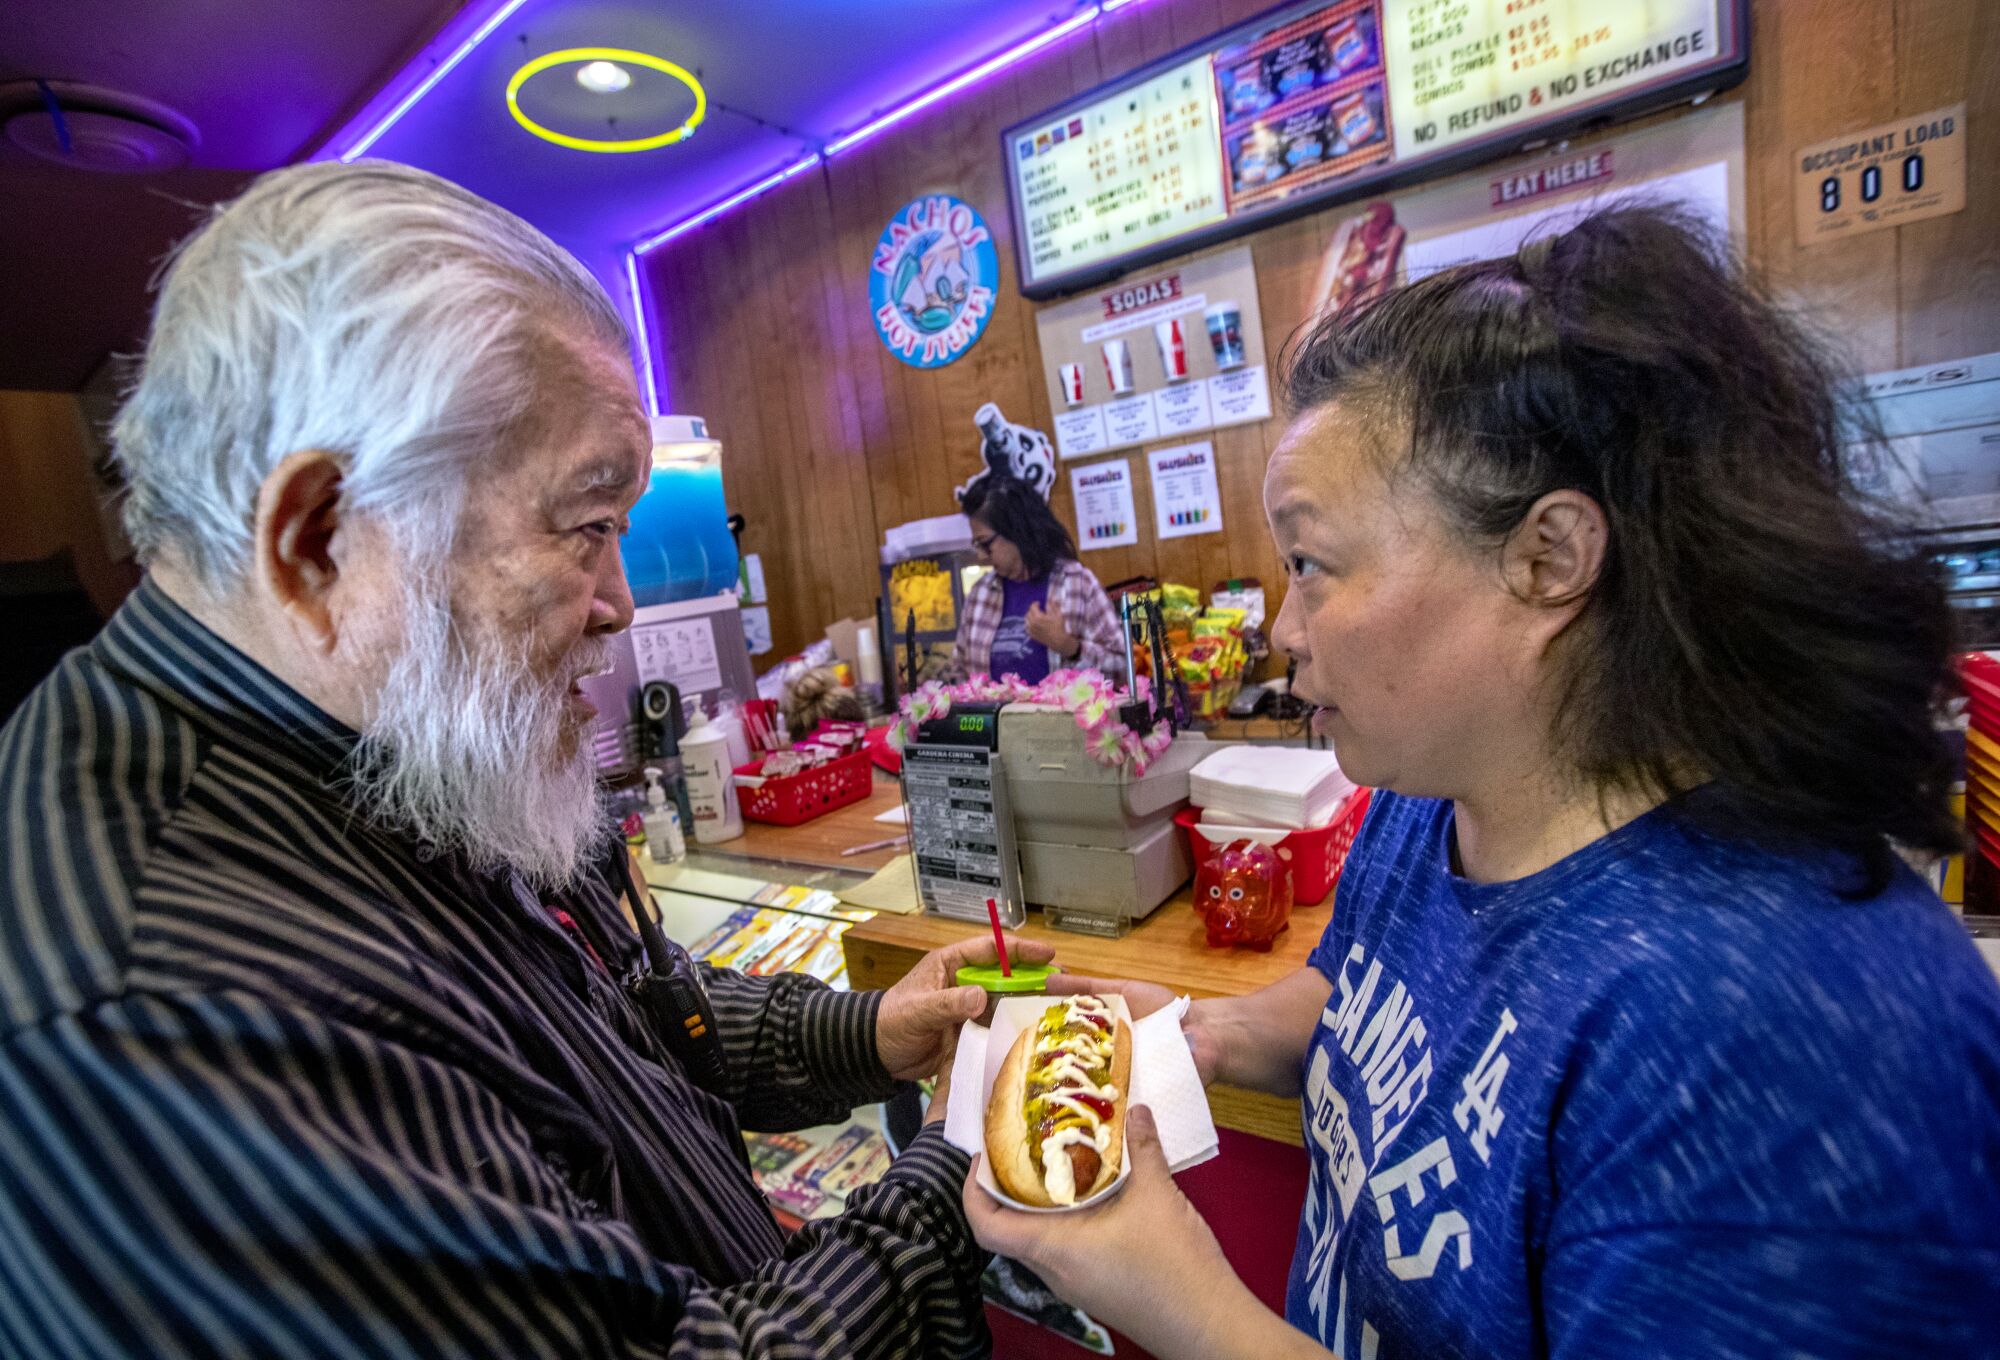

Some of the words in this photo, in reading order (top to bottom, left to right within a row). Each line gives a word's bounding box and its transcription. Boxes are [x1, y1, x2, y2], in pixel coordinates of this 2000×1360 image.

[1450, 32, 1500, 61] PICKLE
[1414, 122, 1437, 144] NO
[1449, 93, 1523, 133] REFUND
[1528, 86, 1543, 107] &
[1549, 74, 1578, 99] NO
[1583, 29, 1706, 87] EXCHANGE
[1801, 132, 1897, 173] OCCUPANT
[1905, 117, 1954, 147] LOAD
[1501, 178, 1540, 201] EAT
[1544, 156, 1601, 192] HERE
[874, 197, 989, 276] NACHOS
[1111, 278, 1173, 313] SODAS
[876, 301, 920, 357] HOT
